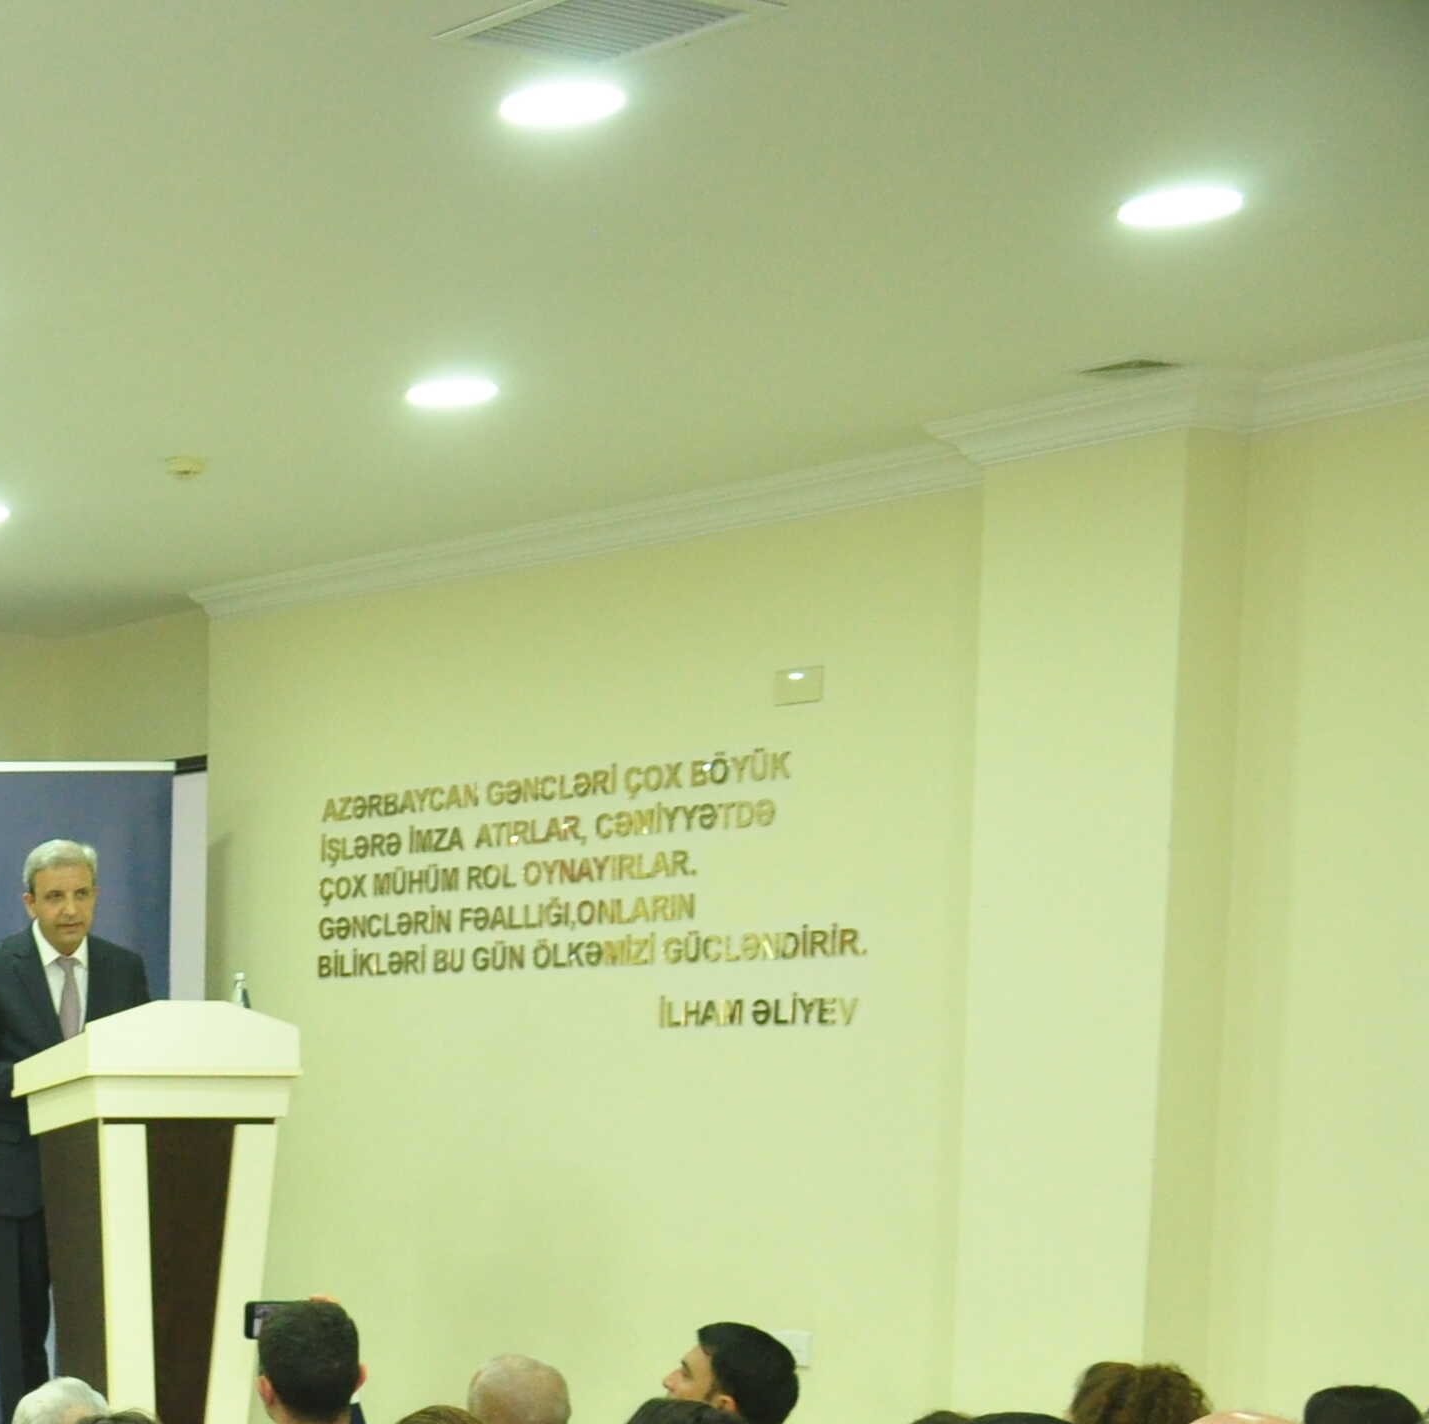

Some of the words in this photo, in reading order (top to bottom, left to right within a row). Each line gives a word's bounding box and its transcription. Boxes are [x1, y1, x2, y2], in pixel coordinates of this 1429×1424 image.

[322, 781, 479, 823] AZƏRBAYCAN
[486, 763, 618, 806] GƏNCLƏRİ
[624, 761, 683, 799] ÇOX
[691, 748, 791, 788] BÖYÜK
[320, 832, 402, 867] İŞLƏRƏ
[409, 824, 464, 854] İMZA
[475, 814, 587, 849] ATIRLAR,
[596, 798, 776, 839] CƏMİYYƏTDƏ
[319, 874, 368, 907] ÇOX
[373, 864, 460, 897] MÜHÜM
[467, 864, 516, 891] ROL
[522, 850, 697, 887] OYNAYIRLAR.
[317, 944, 426, 979] BİLİKLƏRİ
[433, 947, 465, 974] BU
[472, 940, 525, 972] GÜN
[532, 931, 656, 969] ÖLKƏMİZİ
[662, 922, 868, 964] GÜCLƏNDİRİR.
[319, 904, 451, 940] GƏNCLƏRİN
[659, 995, 744, 1029] İLHAM
[752, 992, 859, 1026] ƏLİYEV
